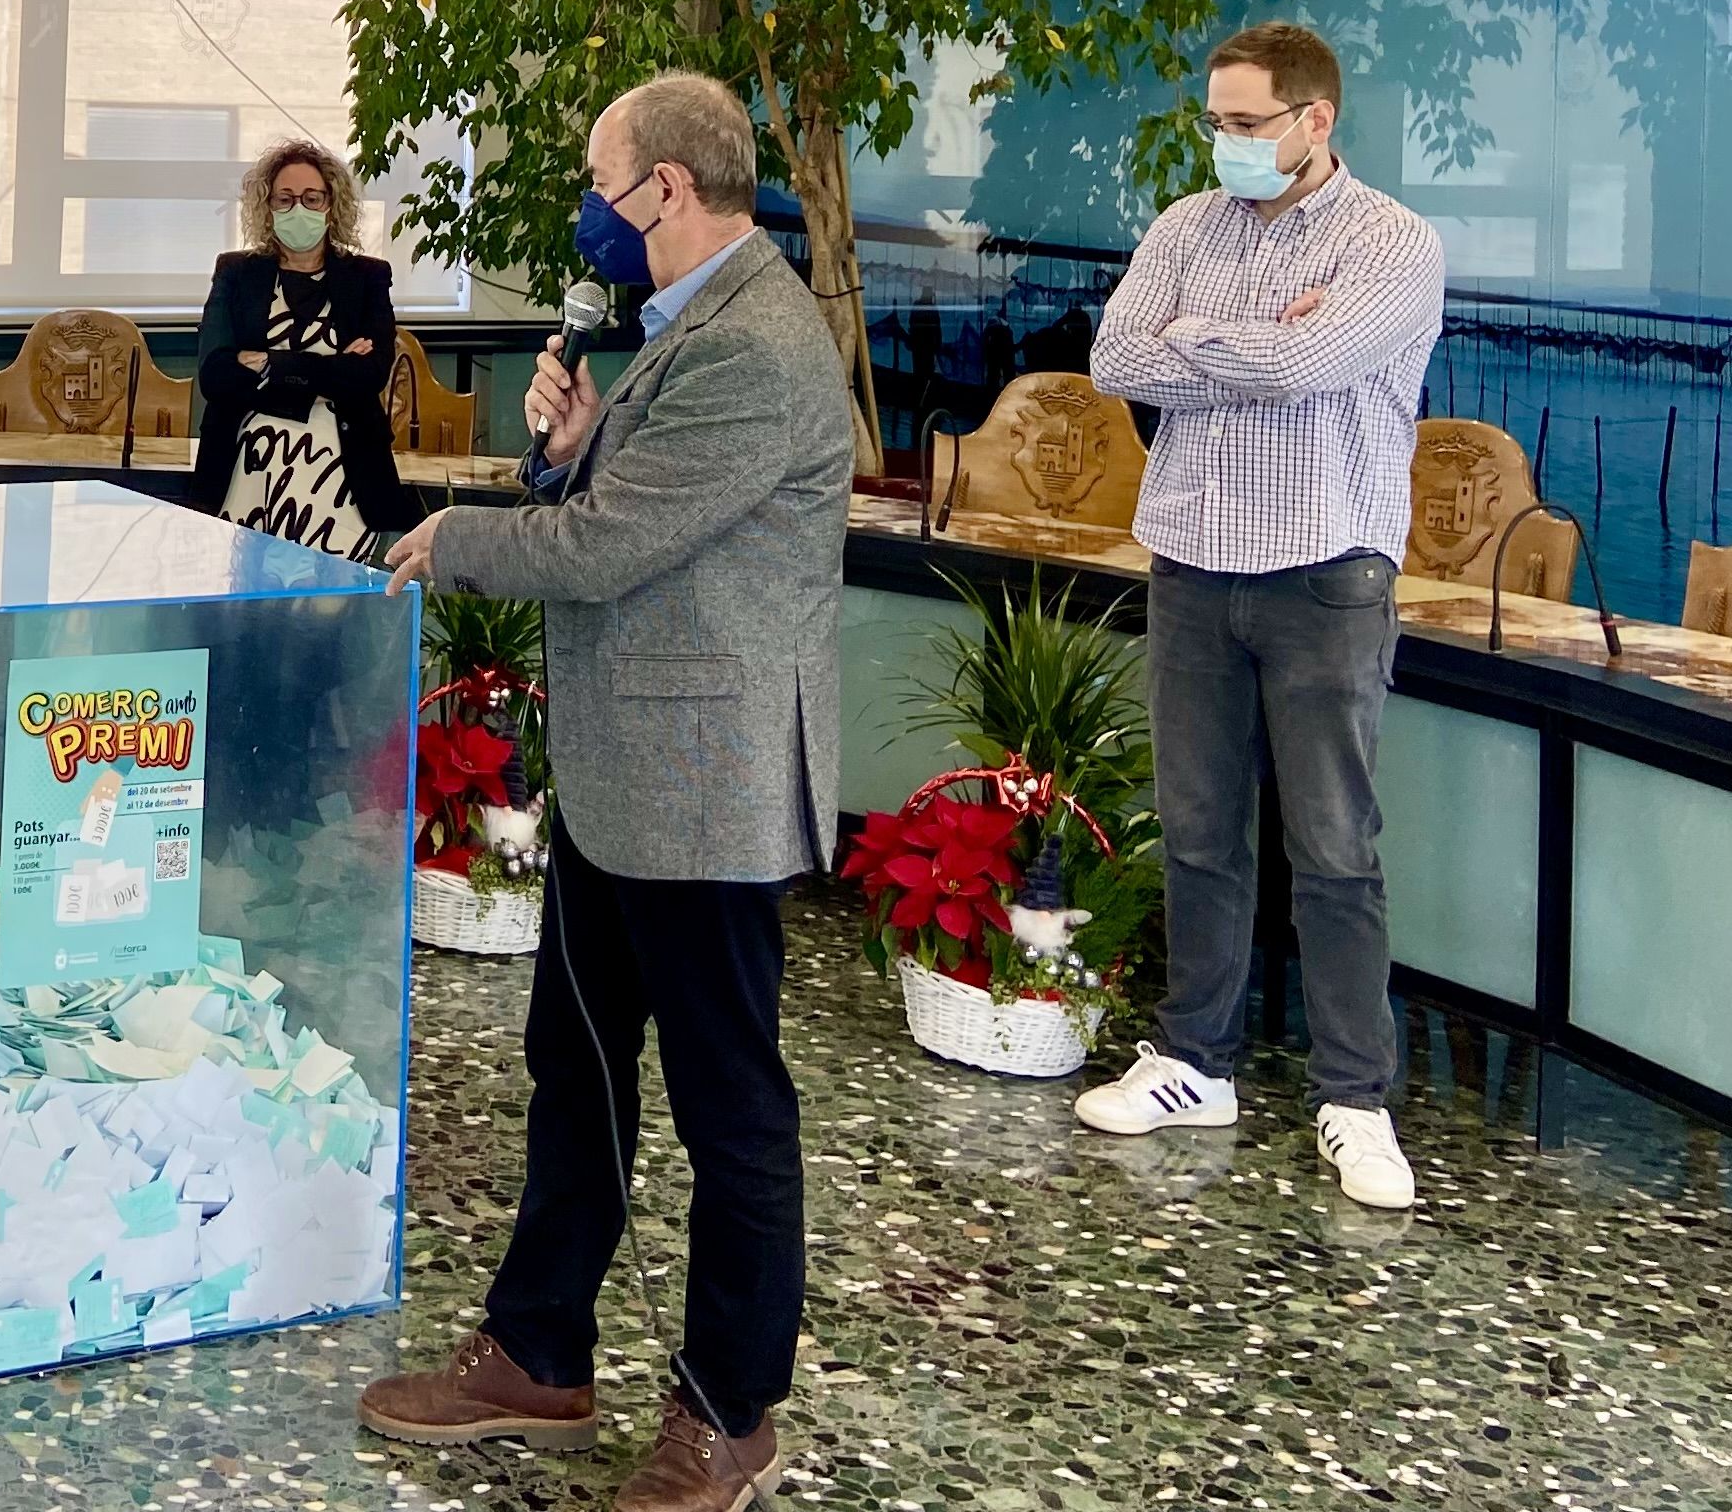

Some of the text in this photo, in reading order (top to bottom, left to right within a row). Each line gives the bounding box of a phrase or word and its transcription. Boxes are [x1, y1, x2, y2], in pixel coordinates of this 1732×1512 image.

[19, 688, 196, 736] COMERÇ amb
[47, 718, 193, 782] PREMI
[127, 787, 138, 796] del
[127, 801, 133, 809] al
[145, 800, 153, 808] de
[14, 820, 44, 834] Pots
[156, 823, 190, 837] +info
[114, 883, 140, 908] 100€
